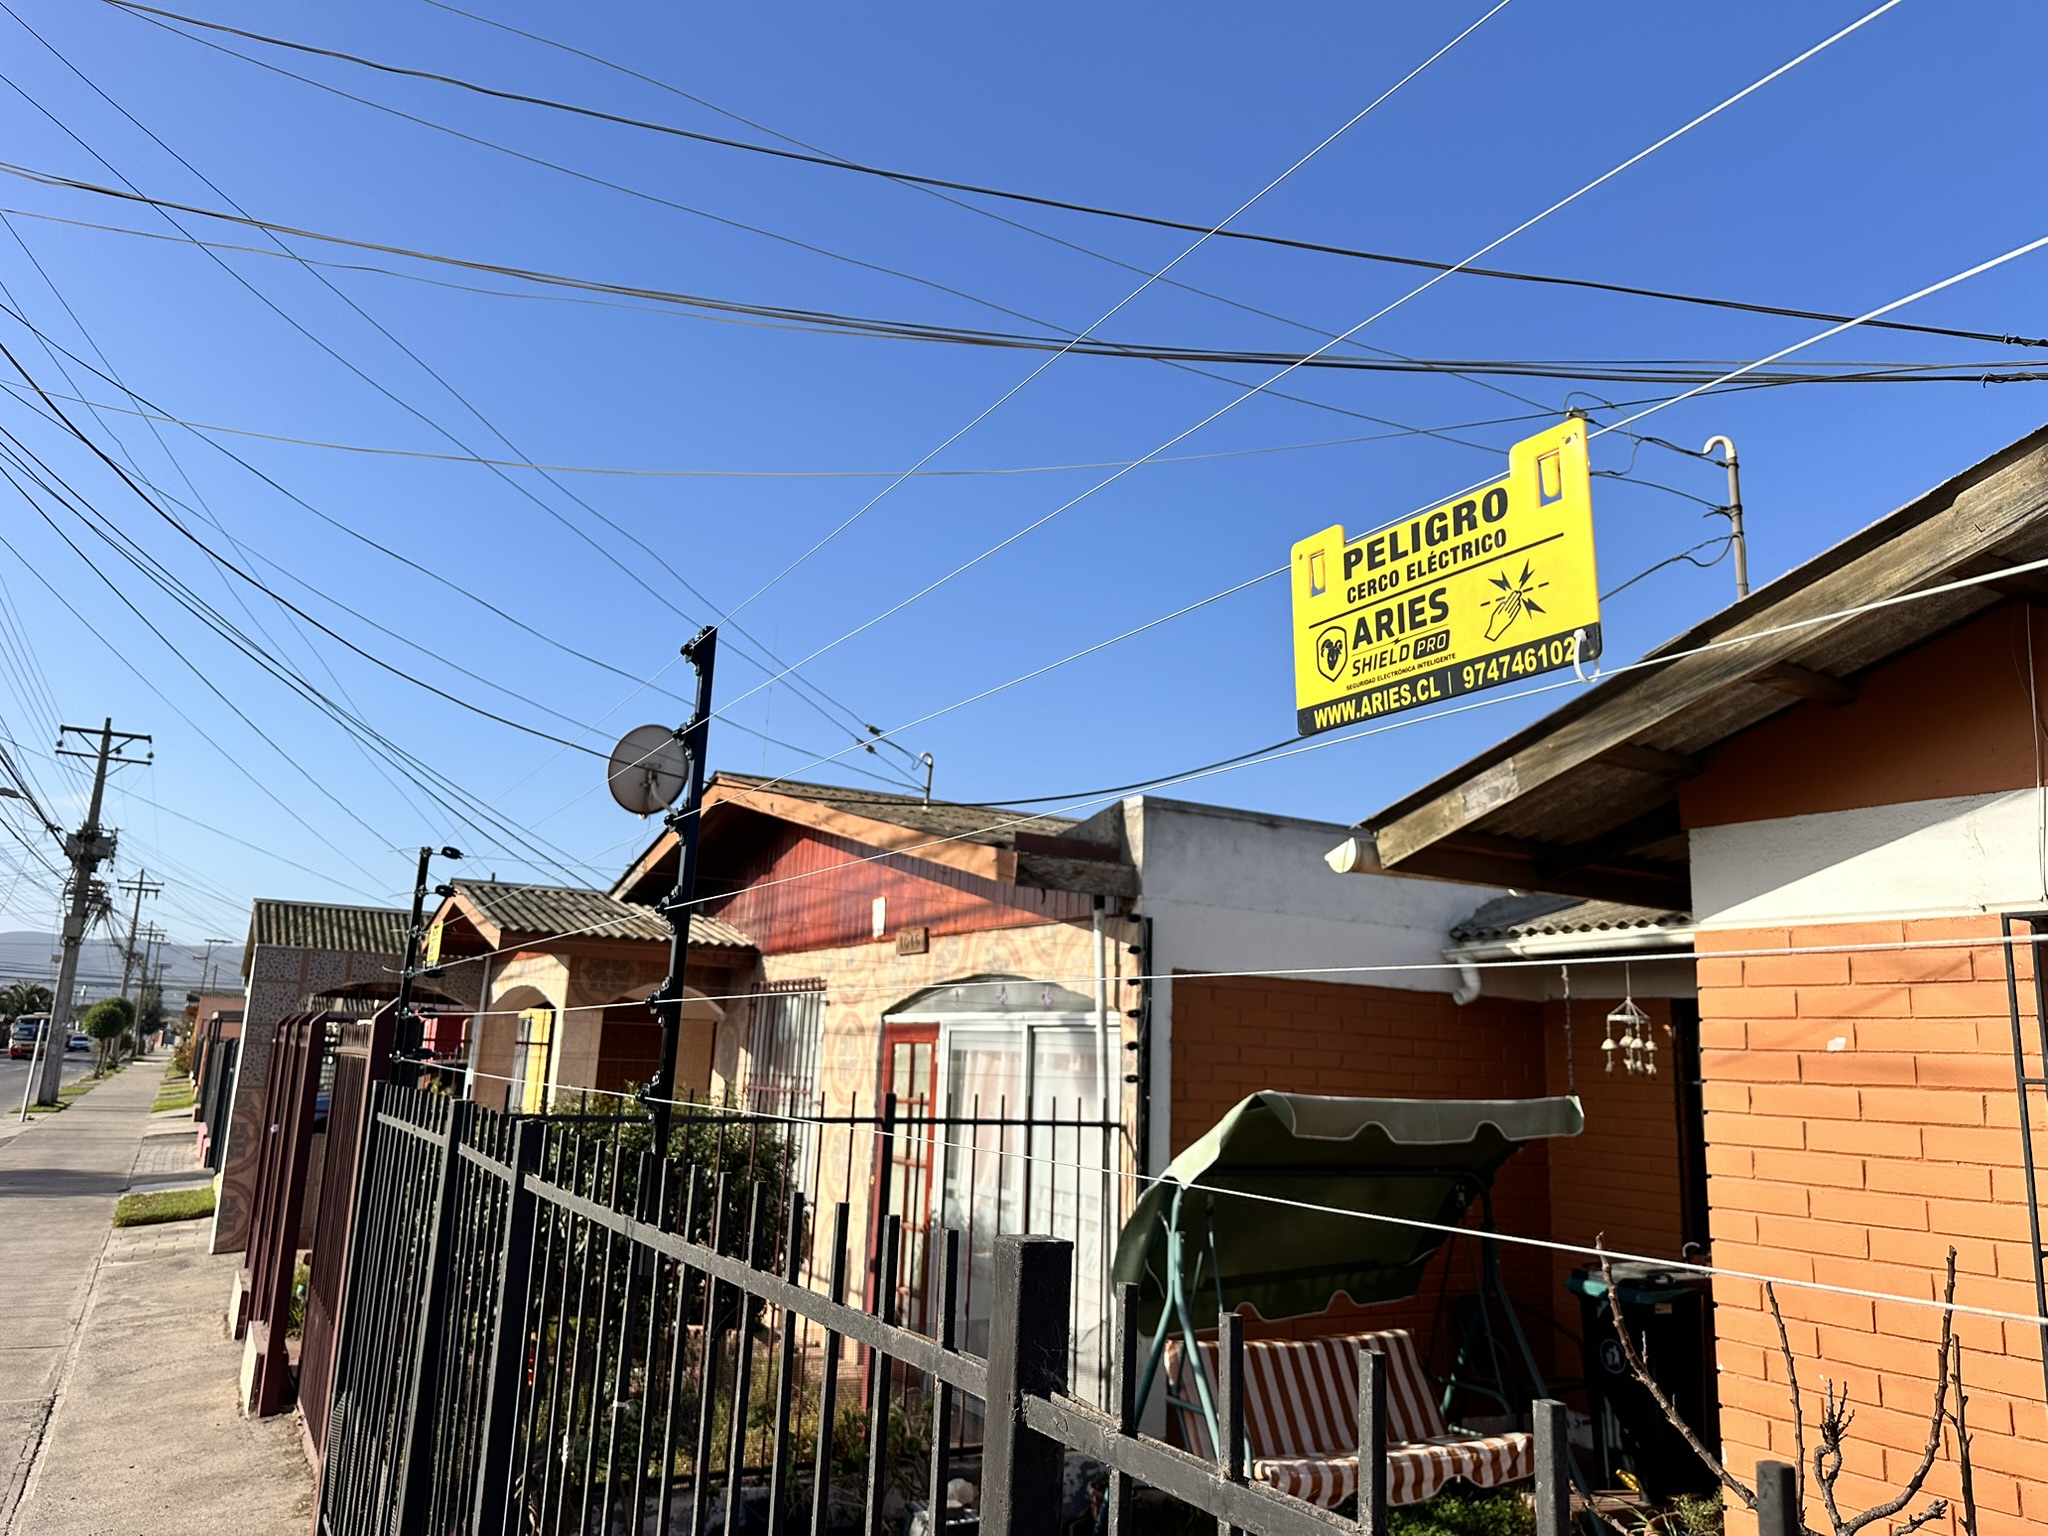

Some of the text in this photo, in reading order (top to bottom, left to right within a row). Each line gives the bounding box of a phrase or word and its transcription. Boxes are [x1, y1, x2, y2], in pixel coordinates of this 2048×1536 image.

[1343, 487, 1508, 581] PELIGRO
[1347, 528, 1507, 604] CERCO ELÉCTRICO
[1352, 587, 1449, 650] ARIES
[1313, 636, 1576, 730] WWW.ARIES.CL 974746102
[1346, 652, 1456, 691] SEGURIDAD ELECTRÓNICA INTELIGENTE
[1352, 633, 1447, 677] SHIELD PRO
